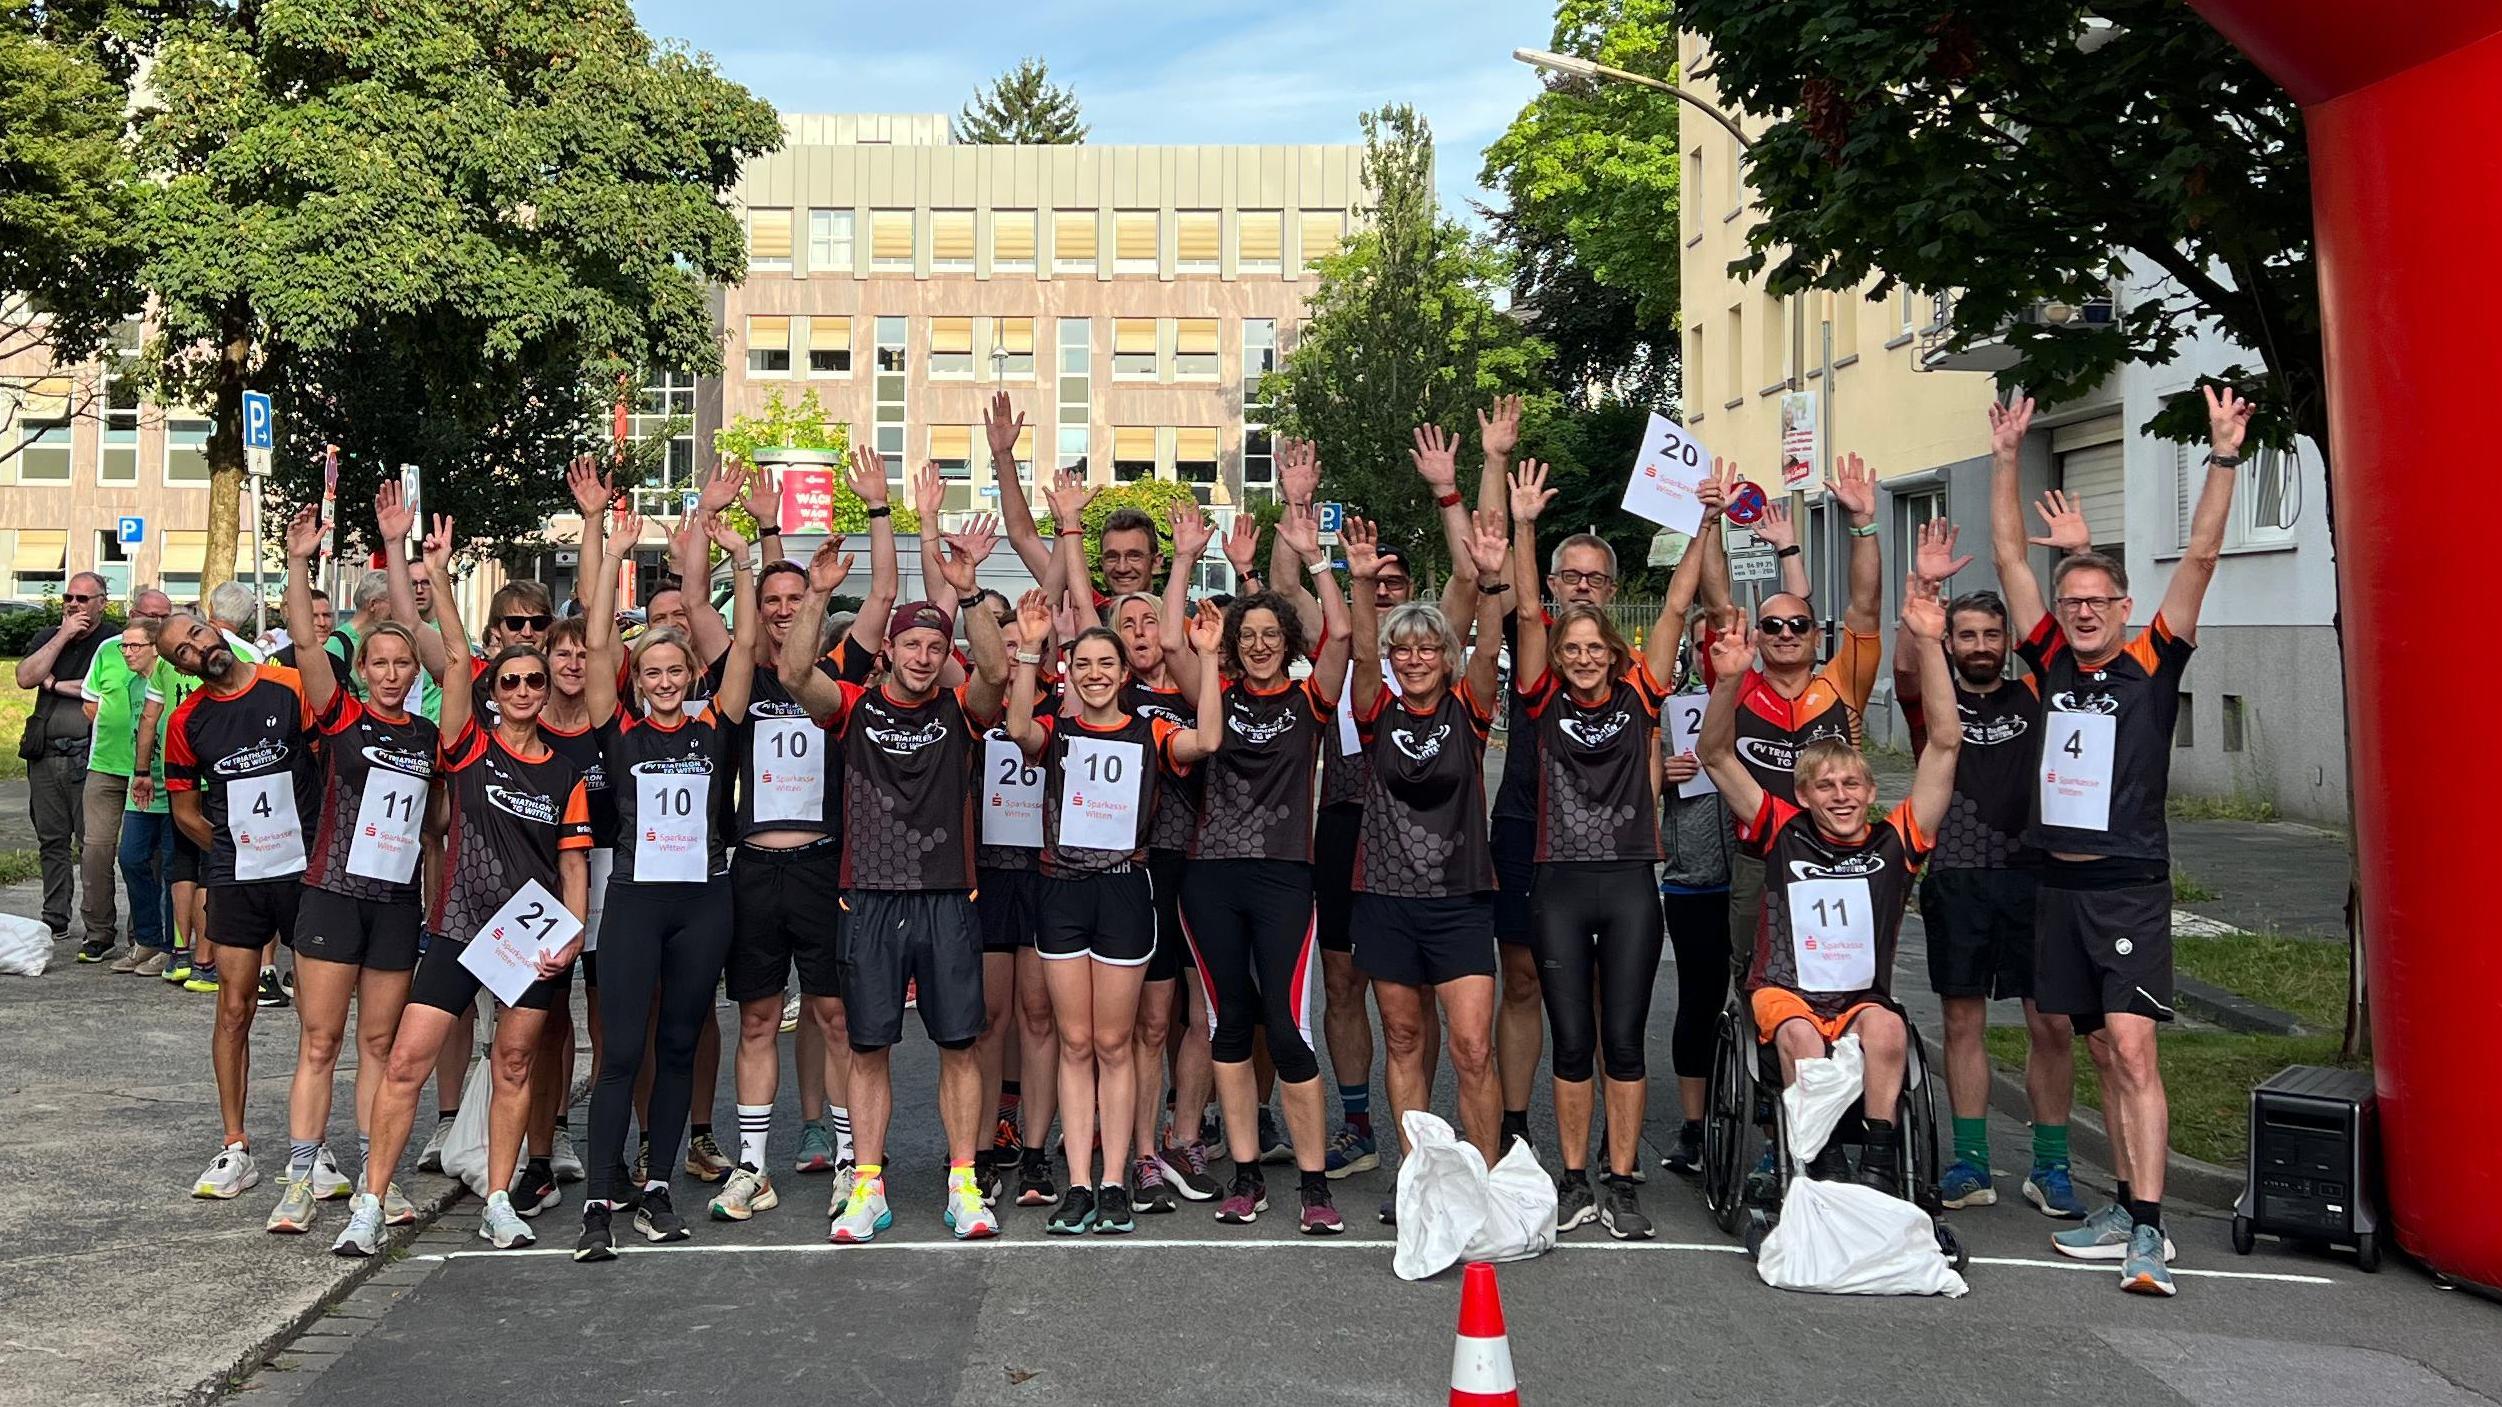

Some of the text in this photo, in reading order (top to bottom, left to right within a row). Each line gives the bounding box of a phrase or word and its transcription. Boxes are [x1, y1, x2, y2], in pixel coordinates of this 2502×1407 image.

[250, 400, 265, 444] P
[1659, 433, 1698, 467] 20
[121, 520, 137, 540] P
[1320, 507, 1335, 529] P
[770, 731, 808, 758] 10
[1753, 742, 1768, 753] PV
[2064, 729, 2082, 759] 4
[998, 758, 1038, 786] 26
[1084, 752, 1123, 783] 10
[1776, 758, 1792, 767] TG
[252, 791, 272, 818] 4
[383, 790, 413, 822] 11
[525, 807, 554, 822] WITTEN
[655, 787, 692, 816] 10
[515, 901, 560, 941] 21
[1811, 898, 1848, 927] 11
